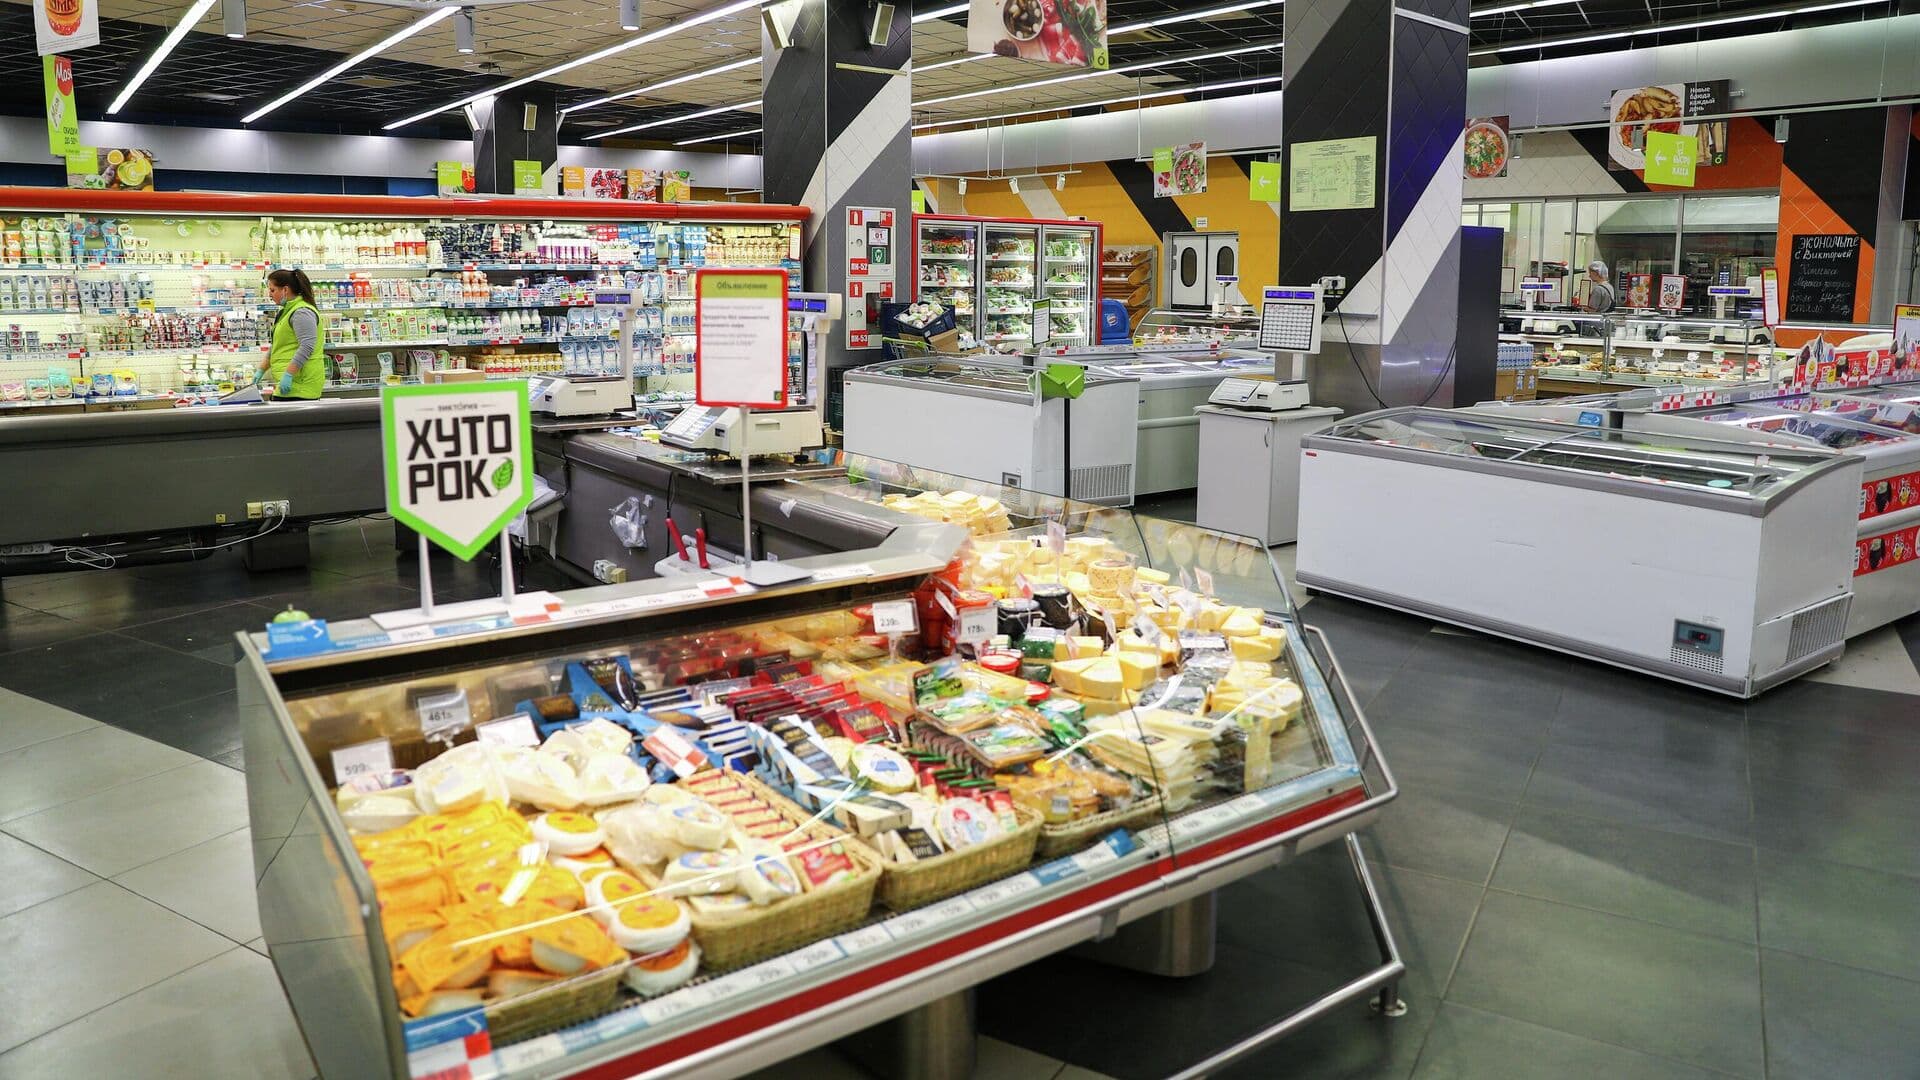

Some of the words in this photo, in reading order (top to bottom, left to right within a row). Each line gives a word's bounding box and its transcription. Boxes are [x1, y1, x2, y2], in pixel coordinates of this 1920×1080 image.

[1803, 249, 1854, 261] Викторией
[716, 281, 769, 291] Объявление
[406, 414, 512, 461] ХУТО
[408, 458, 491, 504] РОК
